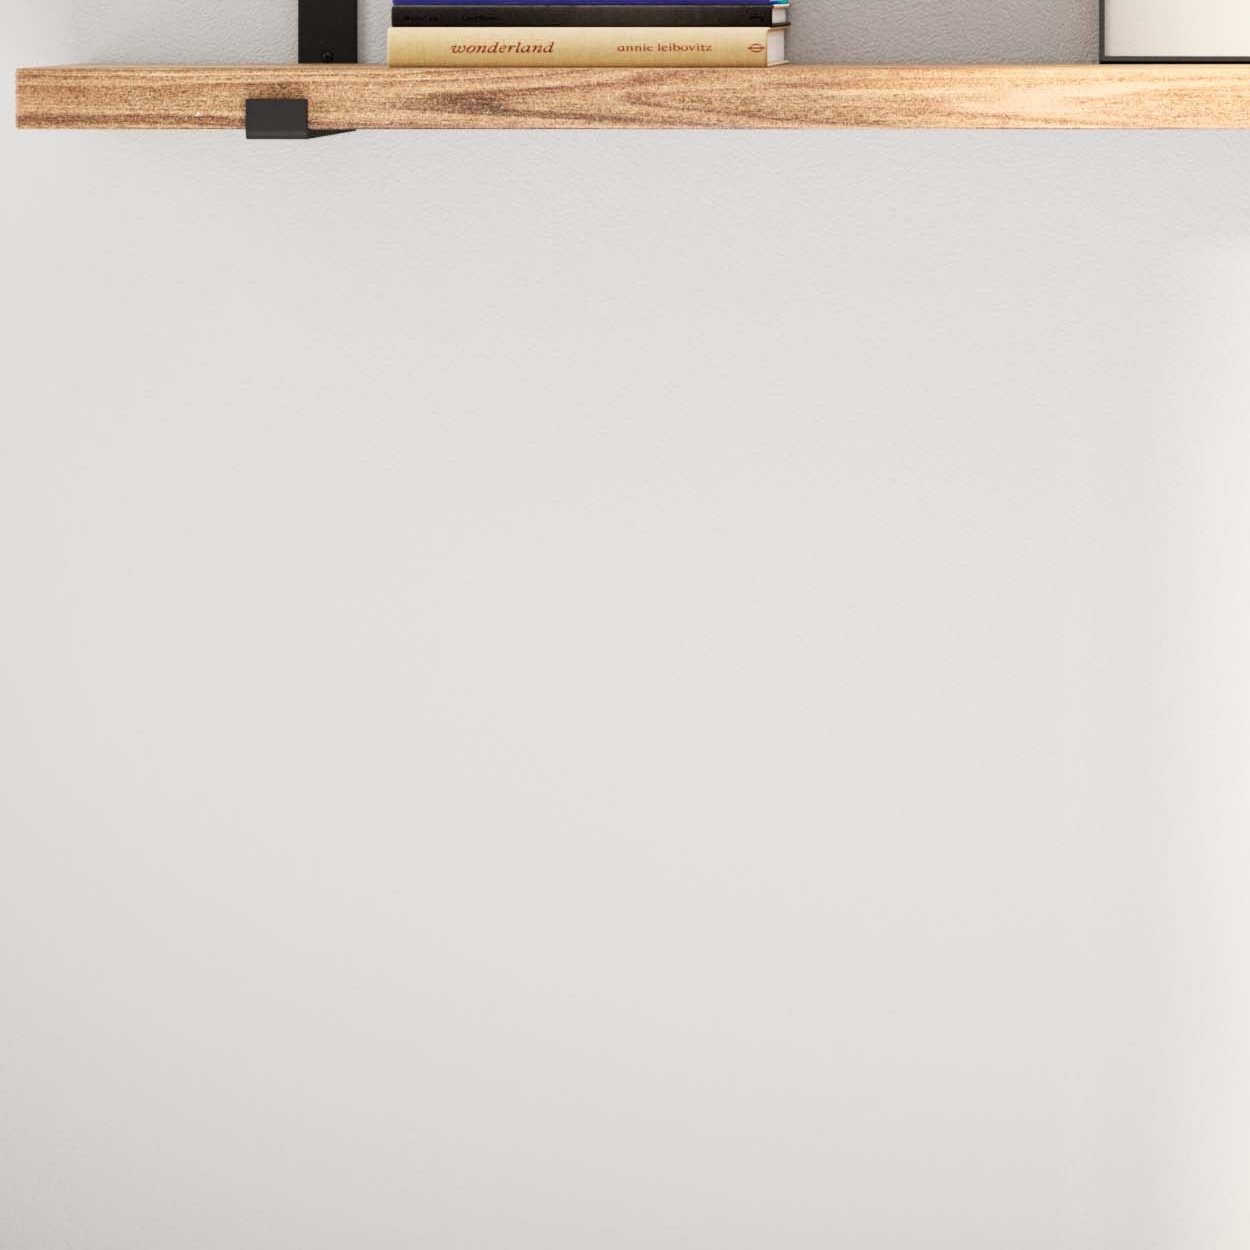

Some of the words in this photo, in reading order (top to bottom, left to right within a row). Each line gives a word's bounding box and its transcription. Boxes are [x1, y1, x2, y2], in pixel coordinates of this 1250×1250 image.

[450, 41, 555, 54] wonderland
[617, 43, 653, 52] annie
[657, 43, 712, 52] leibovitz
